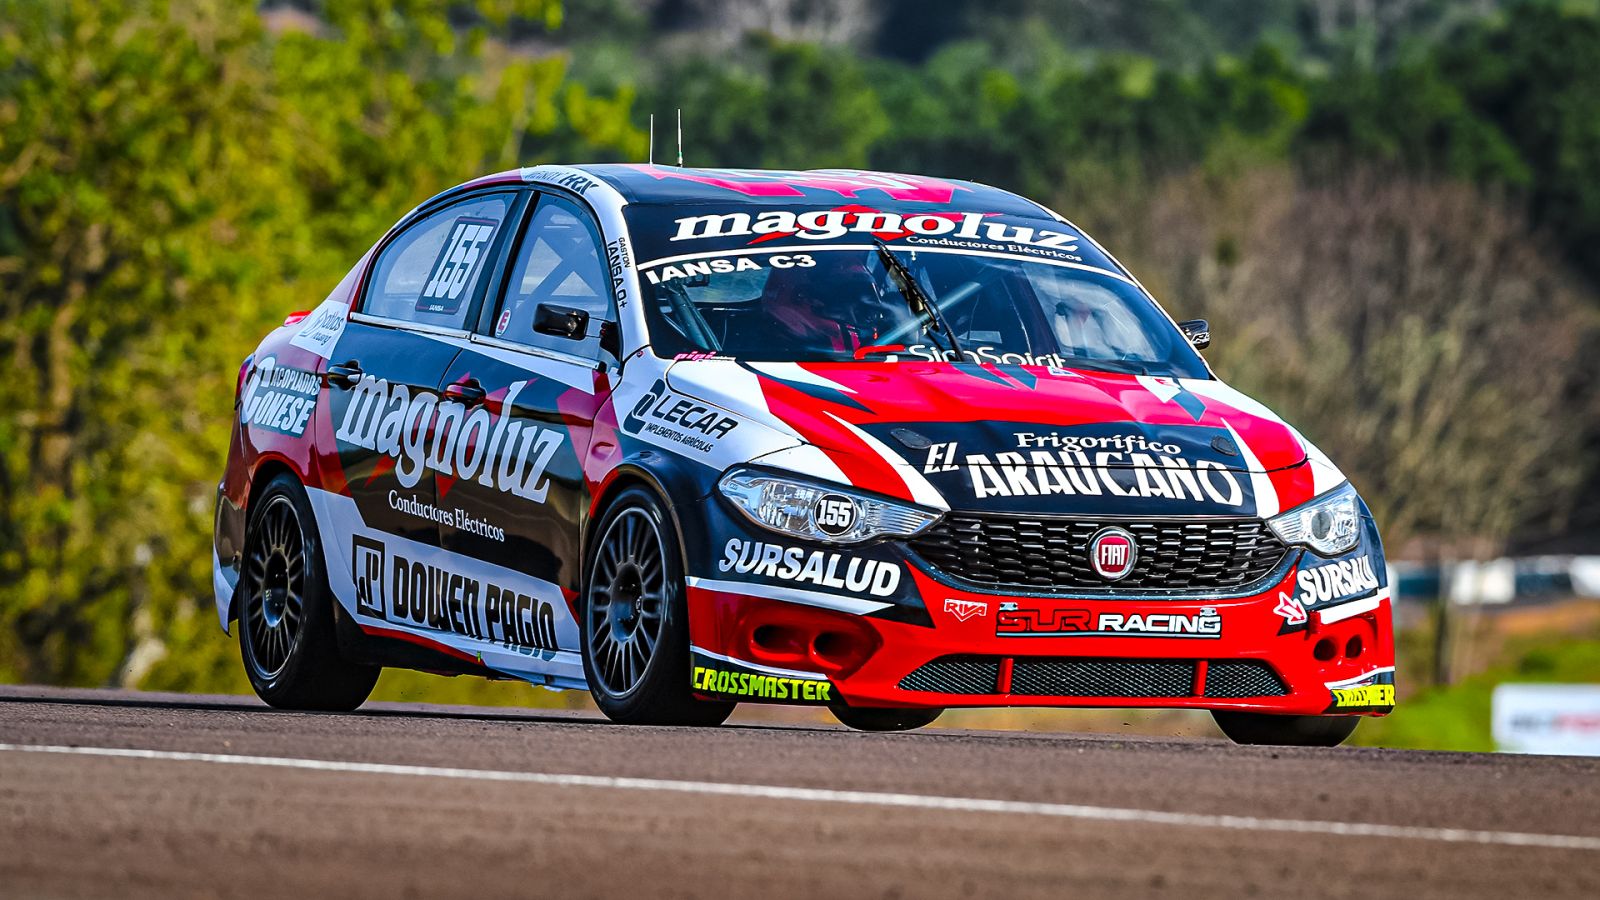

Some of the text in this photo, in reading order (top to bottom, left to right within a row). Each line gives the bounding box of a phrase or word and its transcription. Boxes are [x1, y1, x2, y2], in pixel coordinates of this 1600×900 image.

[670, 210, 1079, 252] magnoluz
[423, 223, 494, 300] 155
[608, 241, 624, 288] IANSA
[618, 237, 630, 268] GASTON
[906, 236, 1082, 262] Conductores Eléctricos
[645, 254, 817, 285] IANSA C3
[271, 367, 323, 395] ACOPLADOS
[652, 395, 739, 440] LECAR
[336, 373, 564, 504] magnoluz
[645, 422, 714, 453] IMPLEMENTOS AGRÍCOLAS
[1013, 432, 1182, 456] Frigorífico
[924, 442, 1243, 507] EL ARAUCANO
[388, 489, 505, 542] Conductores Eléctricos
[818, 500, 852, 527] 155
[719, 538, 901, 597] SURSALUD
[1101, 544, 1126, 566] FIAT
[393, 555, 560, 662] DOWEN PAGIO
[944, 599, 988, 620] RIVA
[997, 609, 1222, 634] SUR RACING
[693, 666, 831, 701] CROSSMASTER
